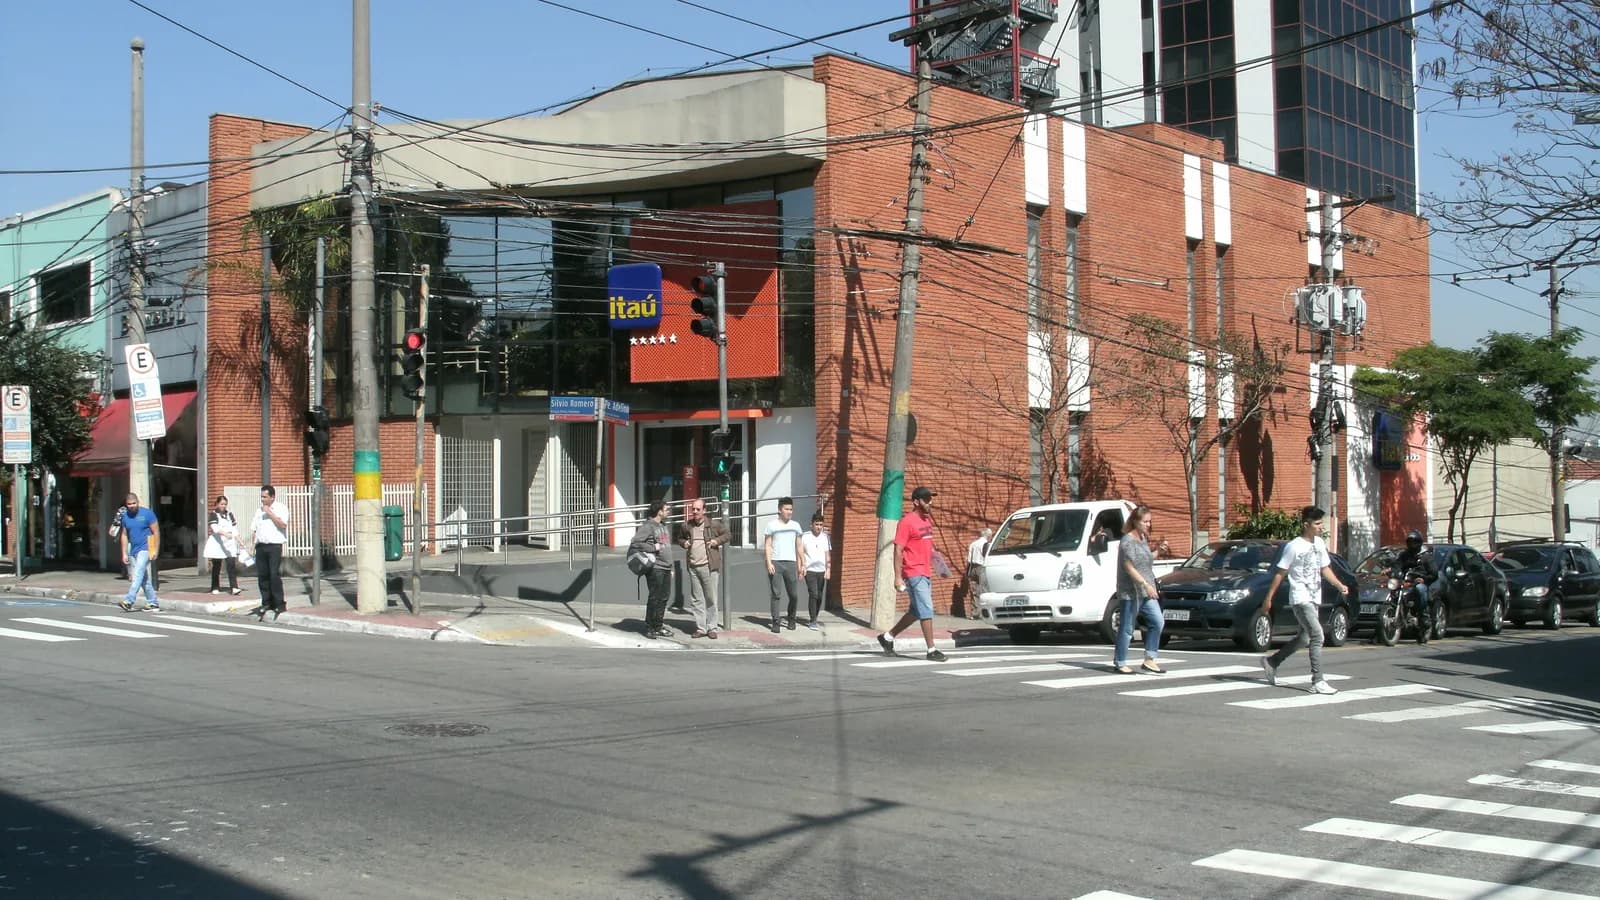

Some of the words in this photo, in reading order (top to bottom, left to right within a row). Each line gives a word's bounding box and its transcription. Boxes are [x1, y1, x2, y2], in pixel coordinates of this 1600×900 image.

[137, 352, 148, 369] E
[12, 393, 21, 406] E
[569, 399, 593, 408] Romero
